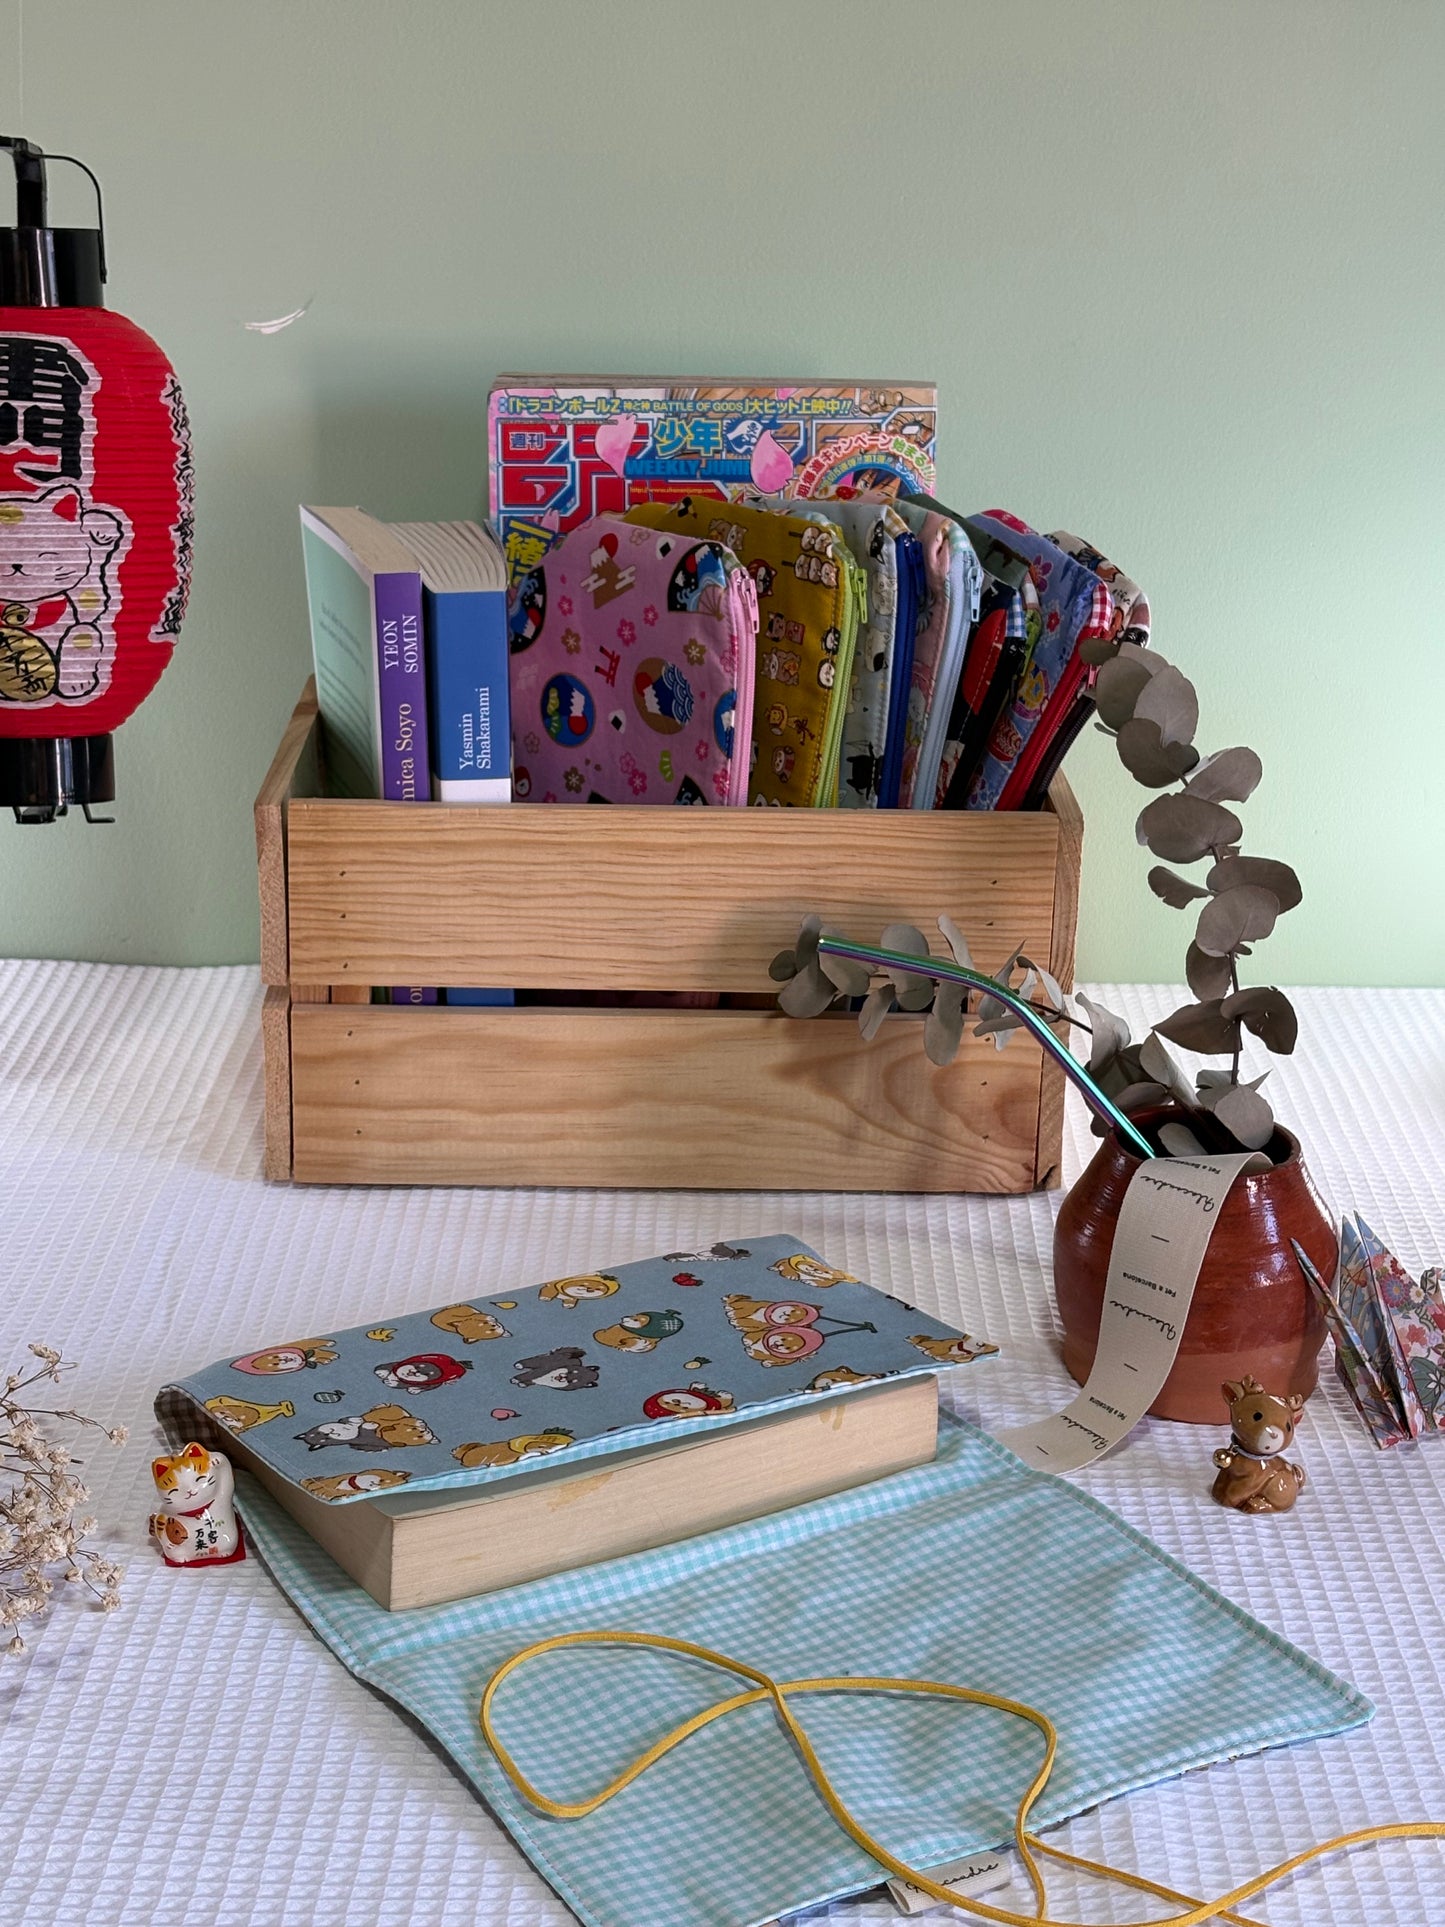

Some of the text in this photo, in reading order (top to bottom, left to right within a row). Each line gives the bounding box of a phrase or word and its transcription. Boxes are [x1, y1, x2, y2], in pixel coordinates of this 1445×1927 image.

[653, 401, 694, 411] BATTLE
[697, 401, 710, 411] OF
[511, 433, 544, 449] 週刊
[655, 418, 723, 456] 少年
[625, 459, 751, 476] WEEKLY JUM
[383, 618, 399, 670] YEON
[402, 614, 418, 673] SOMIN
[458, 713, 473, 770] Yasmin
[475, 686, 490, 769] Shakarami
[396, 704, 416, 800] mica Soyo
[1122, 1272, 1157, 1291] Barcelona
[1164, 1287, 1176, 1298] Fet
